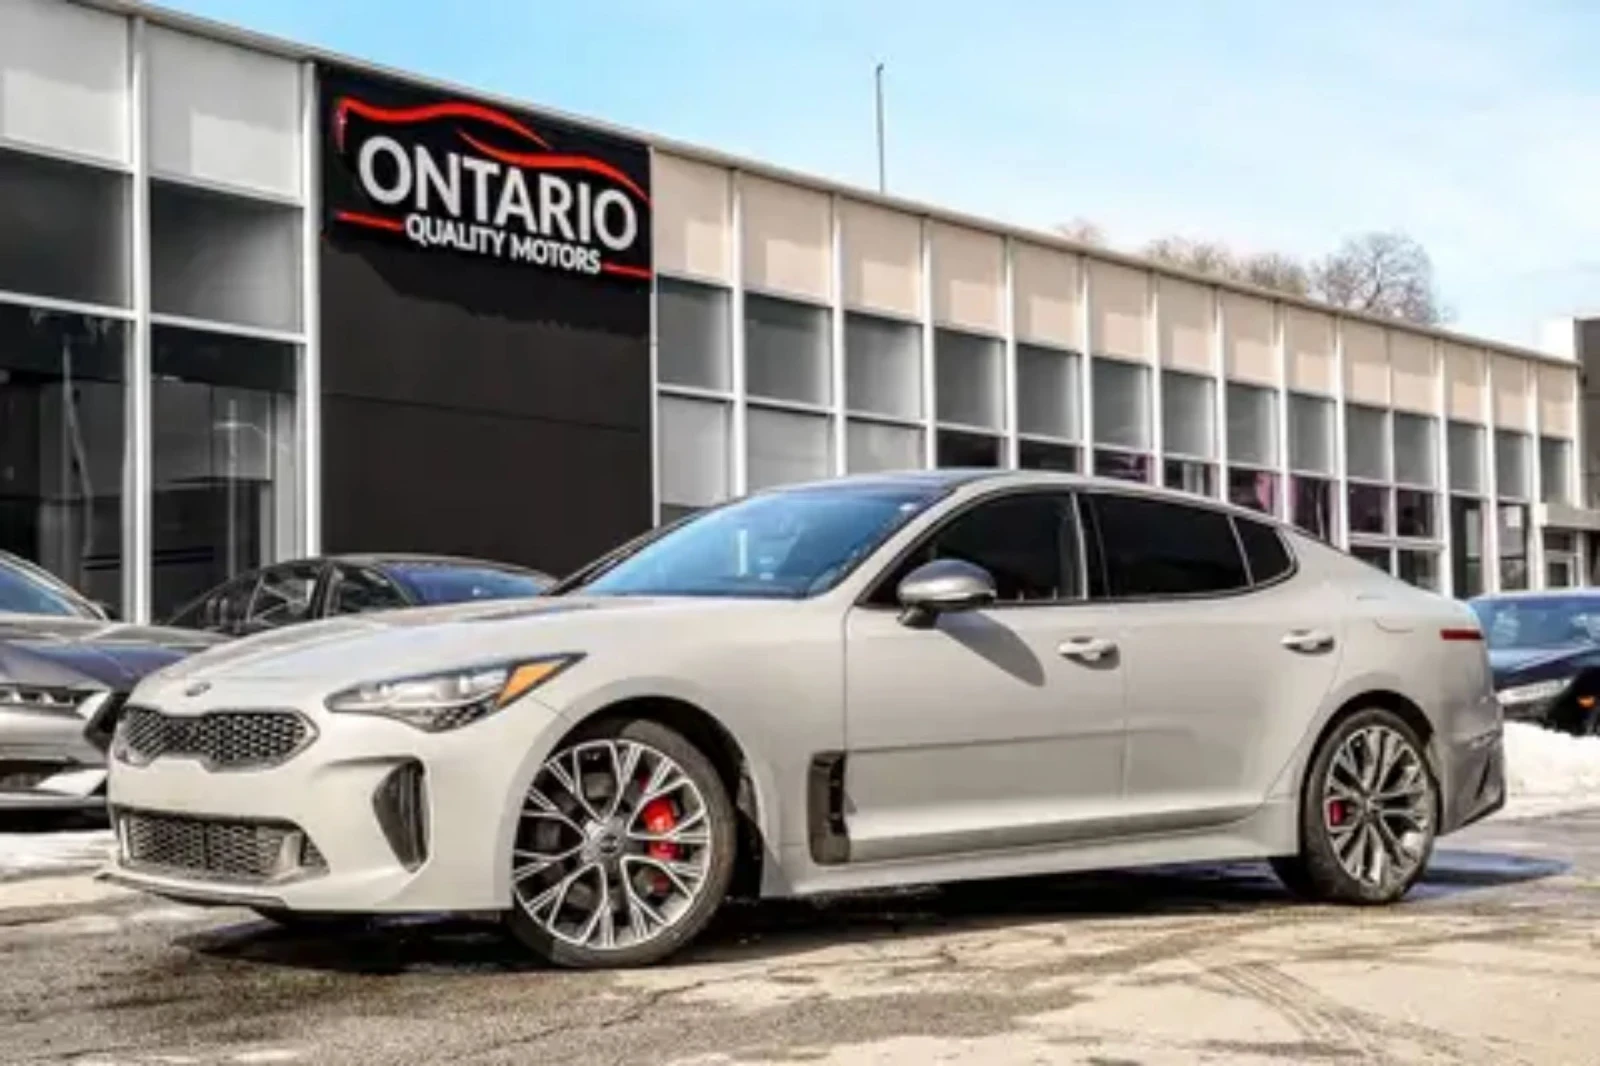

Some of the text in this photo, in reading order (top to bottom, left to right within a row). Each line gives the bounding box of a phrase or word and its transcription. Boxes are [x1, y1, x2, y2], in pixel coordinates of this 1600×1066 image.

[358, 136, 638, 250] ONTARIO
[405, 213, 601, 274] QUALITY MOTORS
